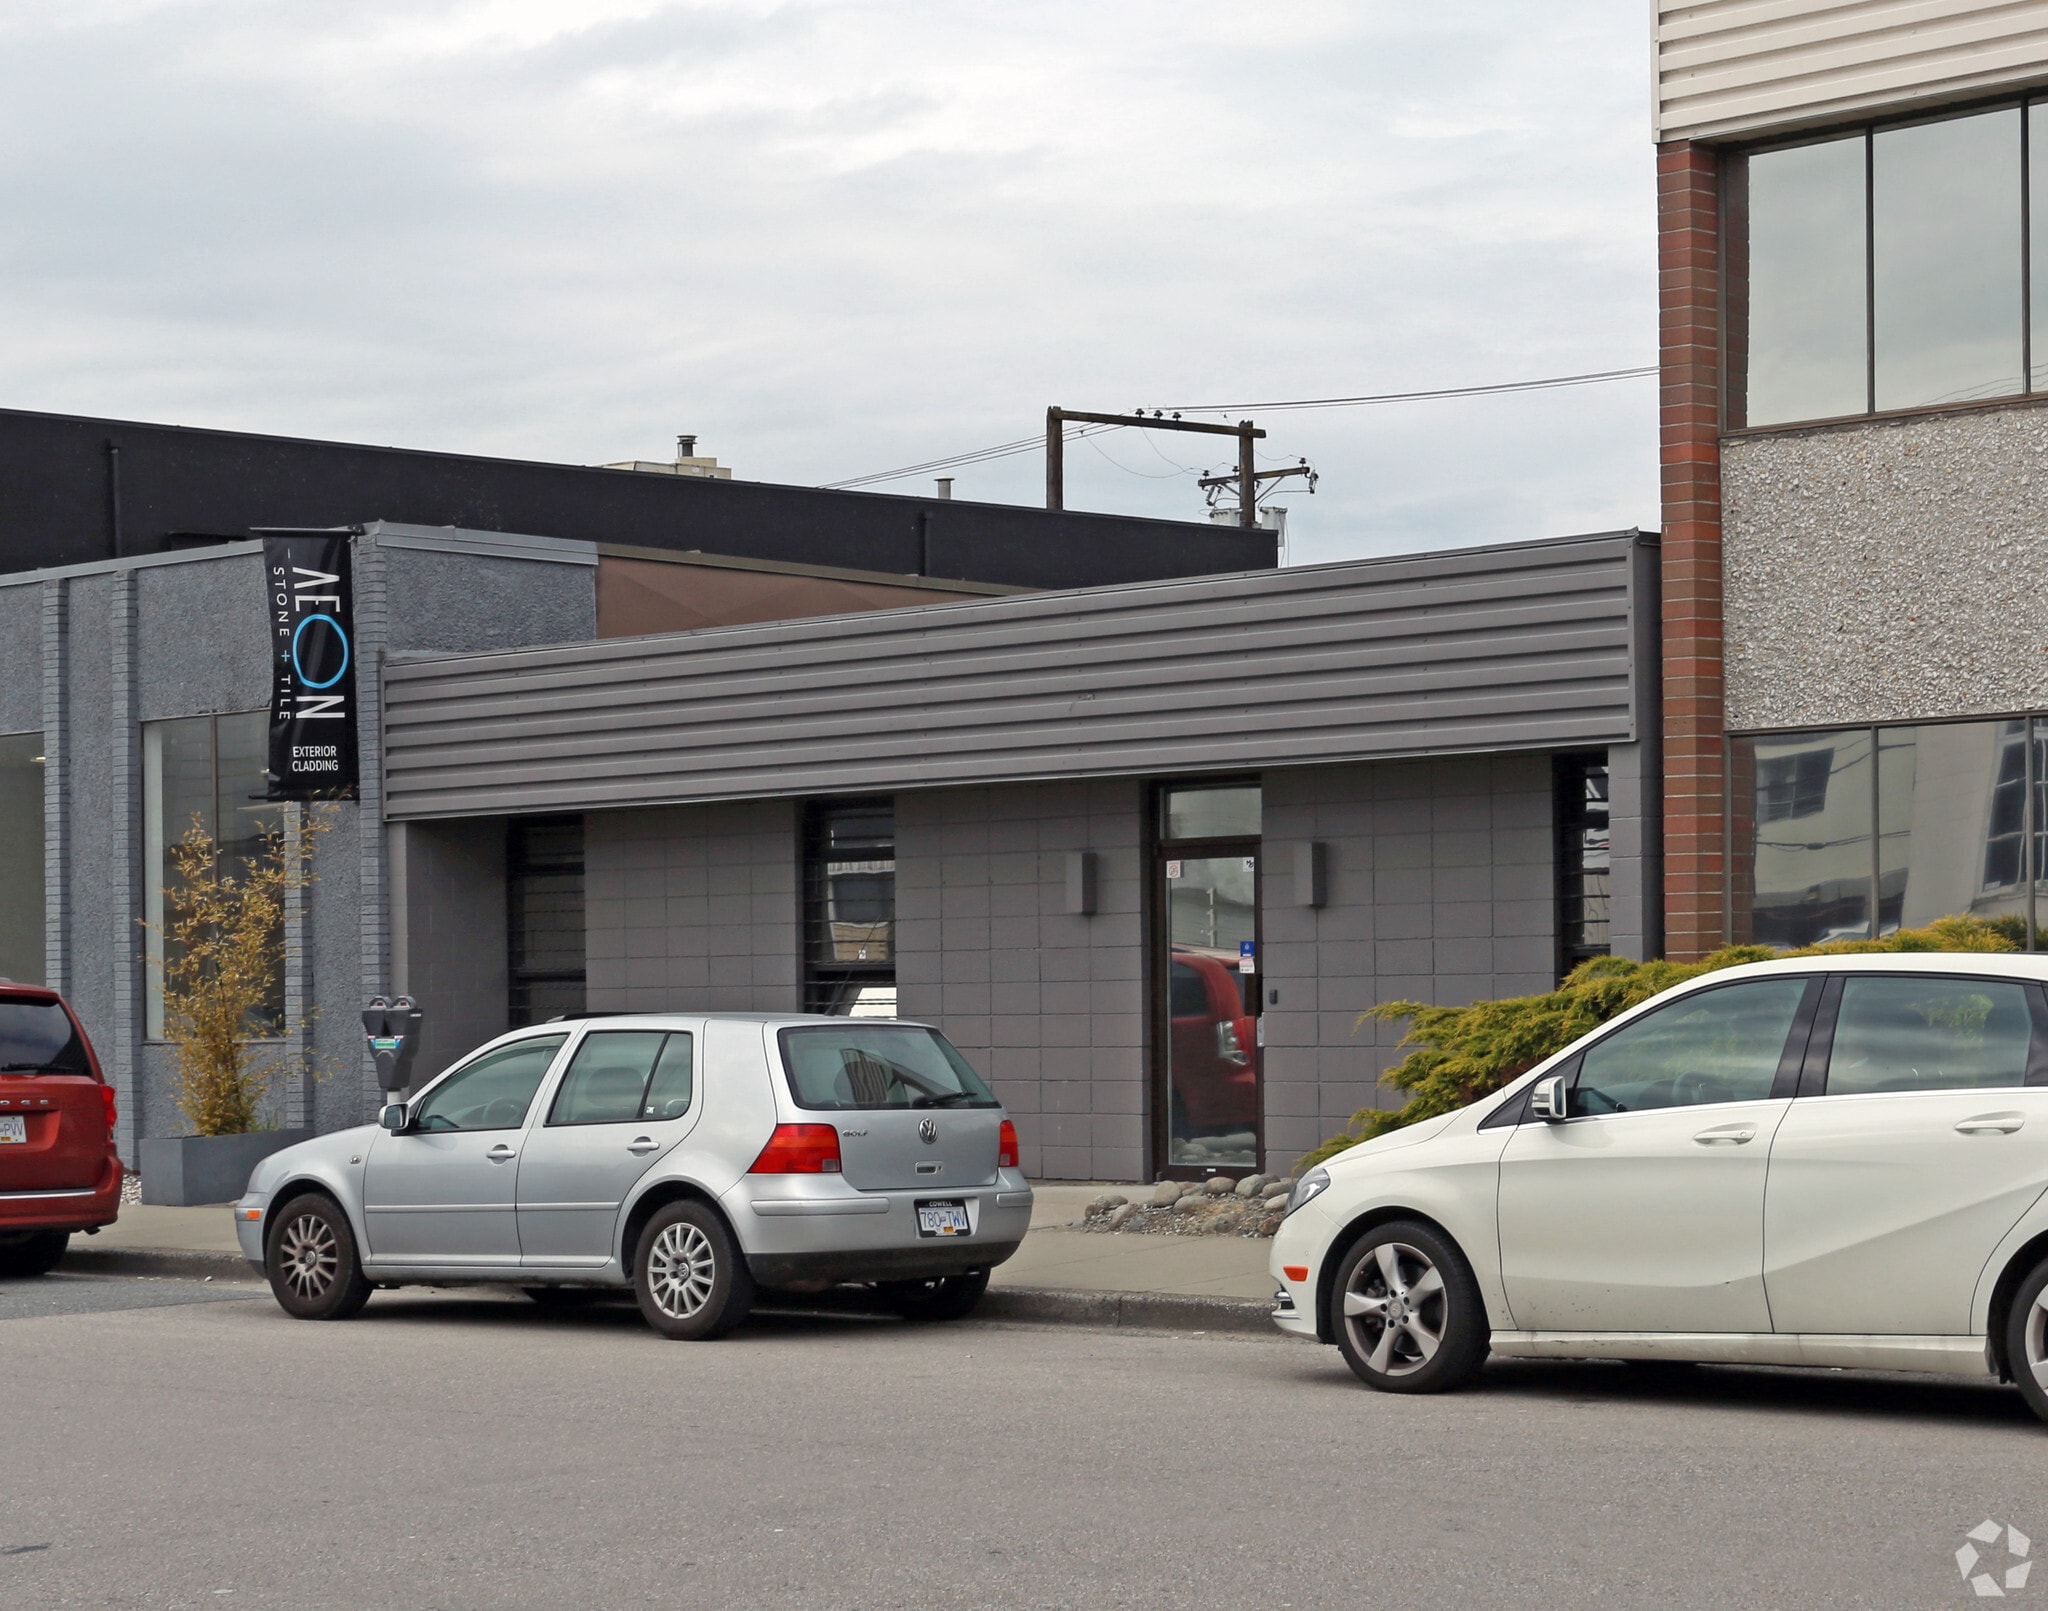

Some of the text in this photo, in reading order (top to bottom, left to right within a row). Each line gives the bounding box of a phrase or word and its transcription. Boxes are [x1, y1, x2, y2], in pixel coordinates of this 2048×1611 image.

[273, 566, 290, 636] STONE
[292, 566, 348, 719] AEON
[279, 674, 291, 719] TILE
[292, 759, 339, 772] CLADDING
[293, 745, 337, 758] EXTERIOR
